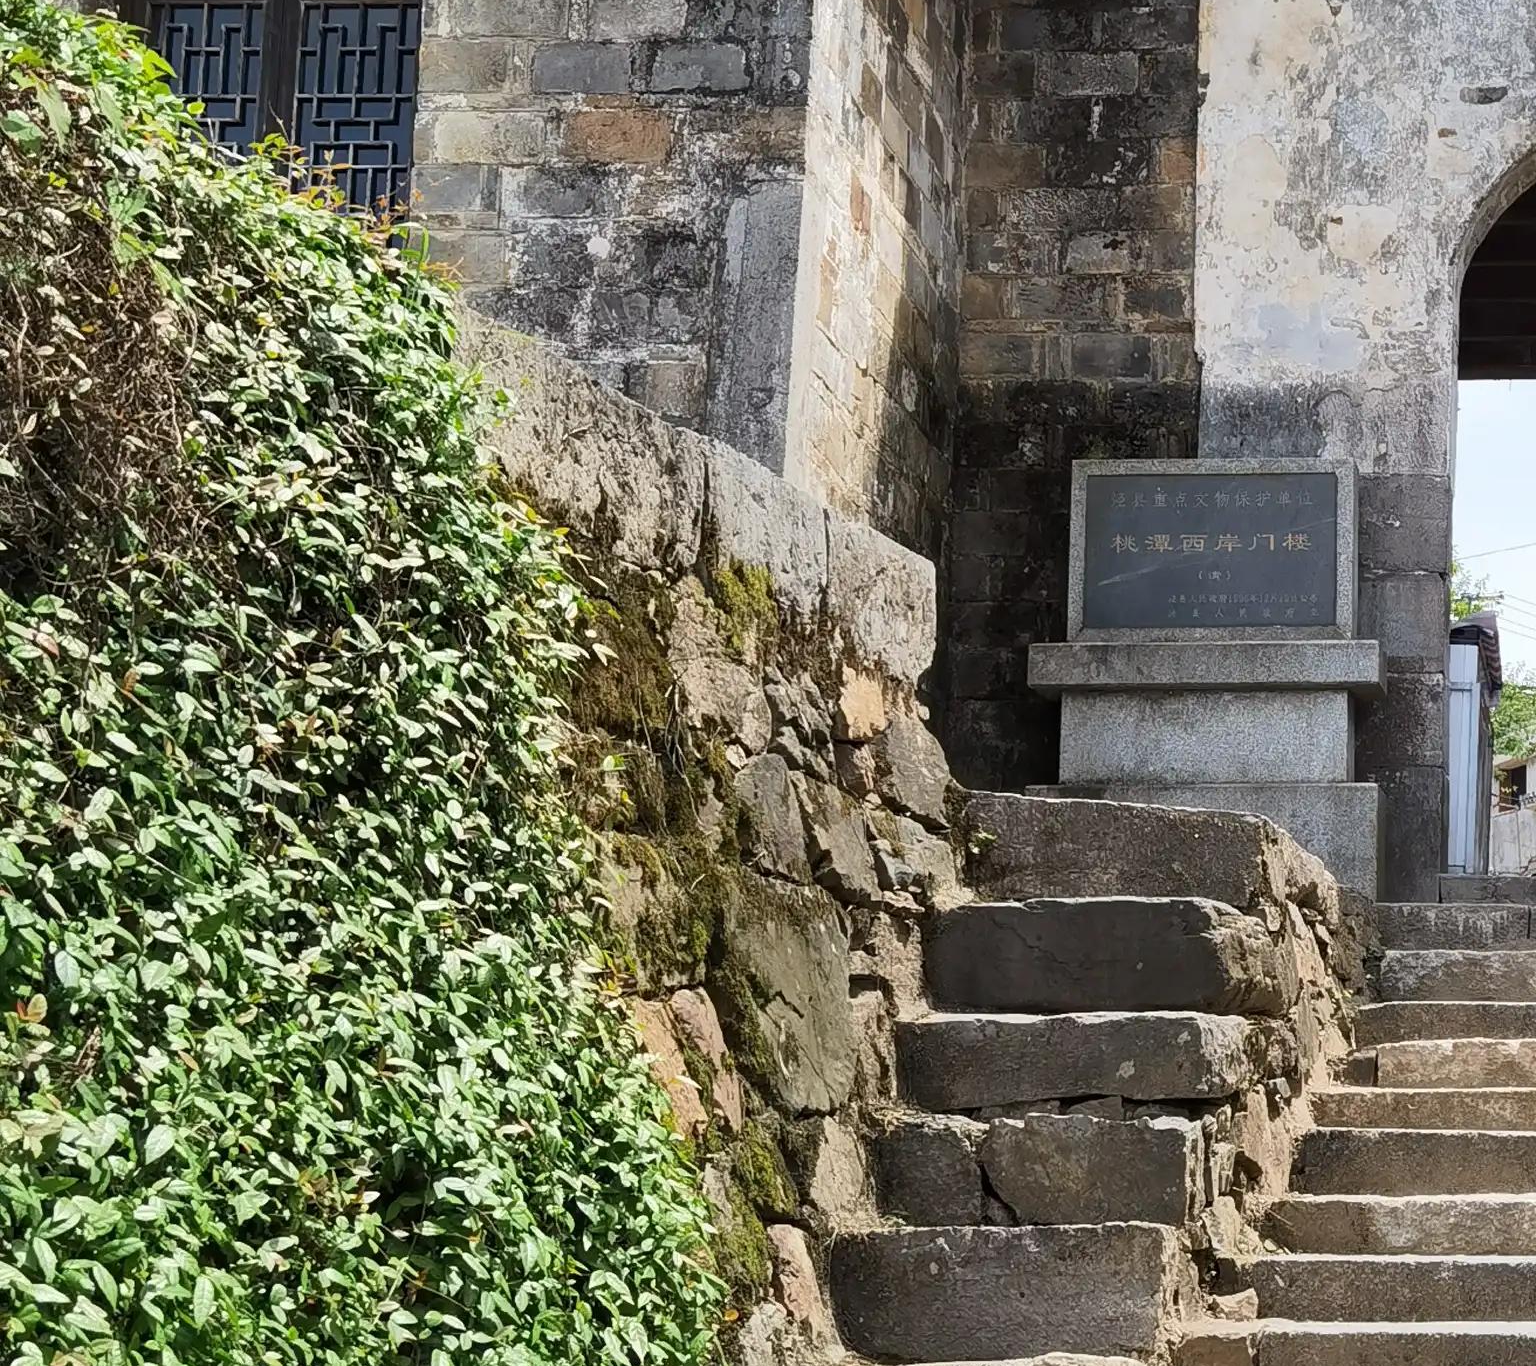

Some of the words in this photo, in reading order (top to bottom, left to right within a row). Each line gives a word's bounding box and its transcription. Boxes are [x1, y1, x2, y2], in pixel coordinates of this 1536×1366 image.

[1110, 490, 1314, 509] 泾县重点文物保护单位
[1109, 532, 1313, 555] 桃潭西岸门楼
